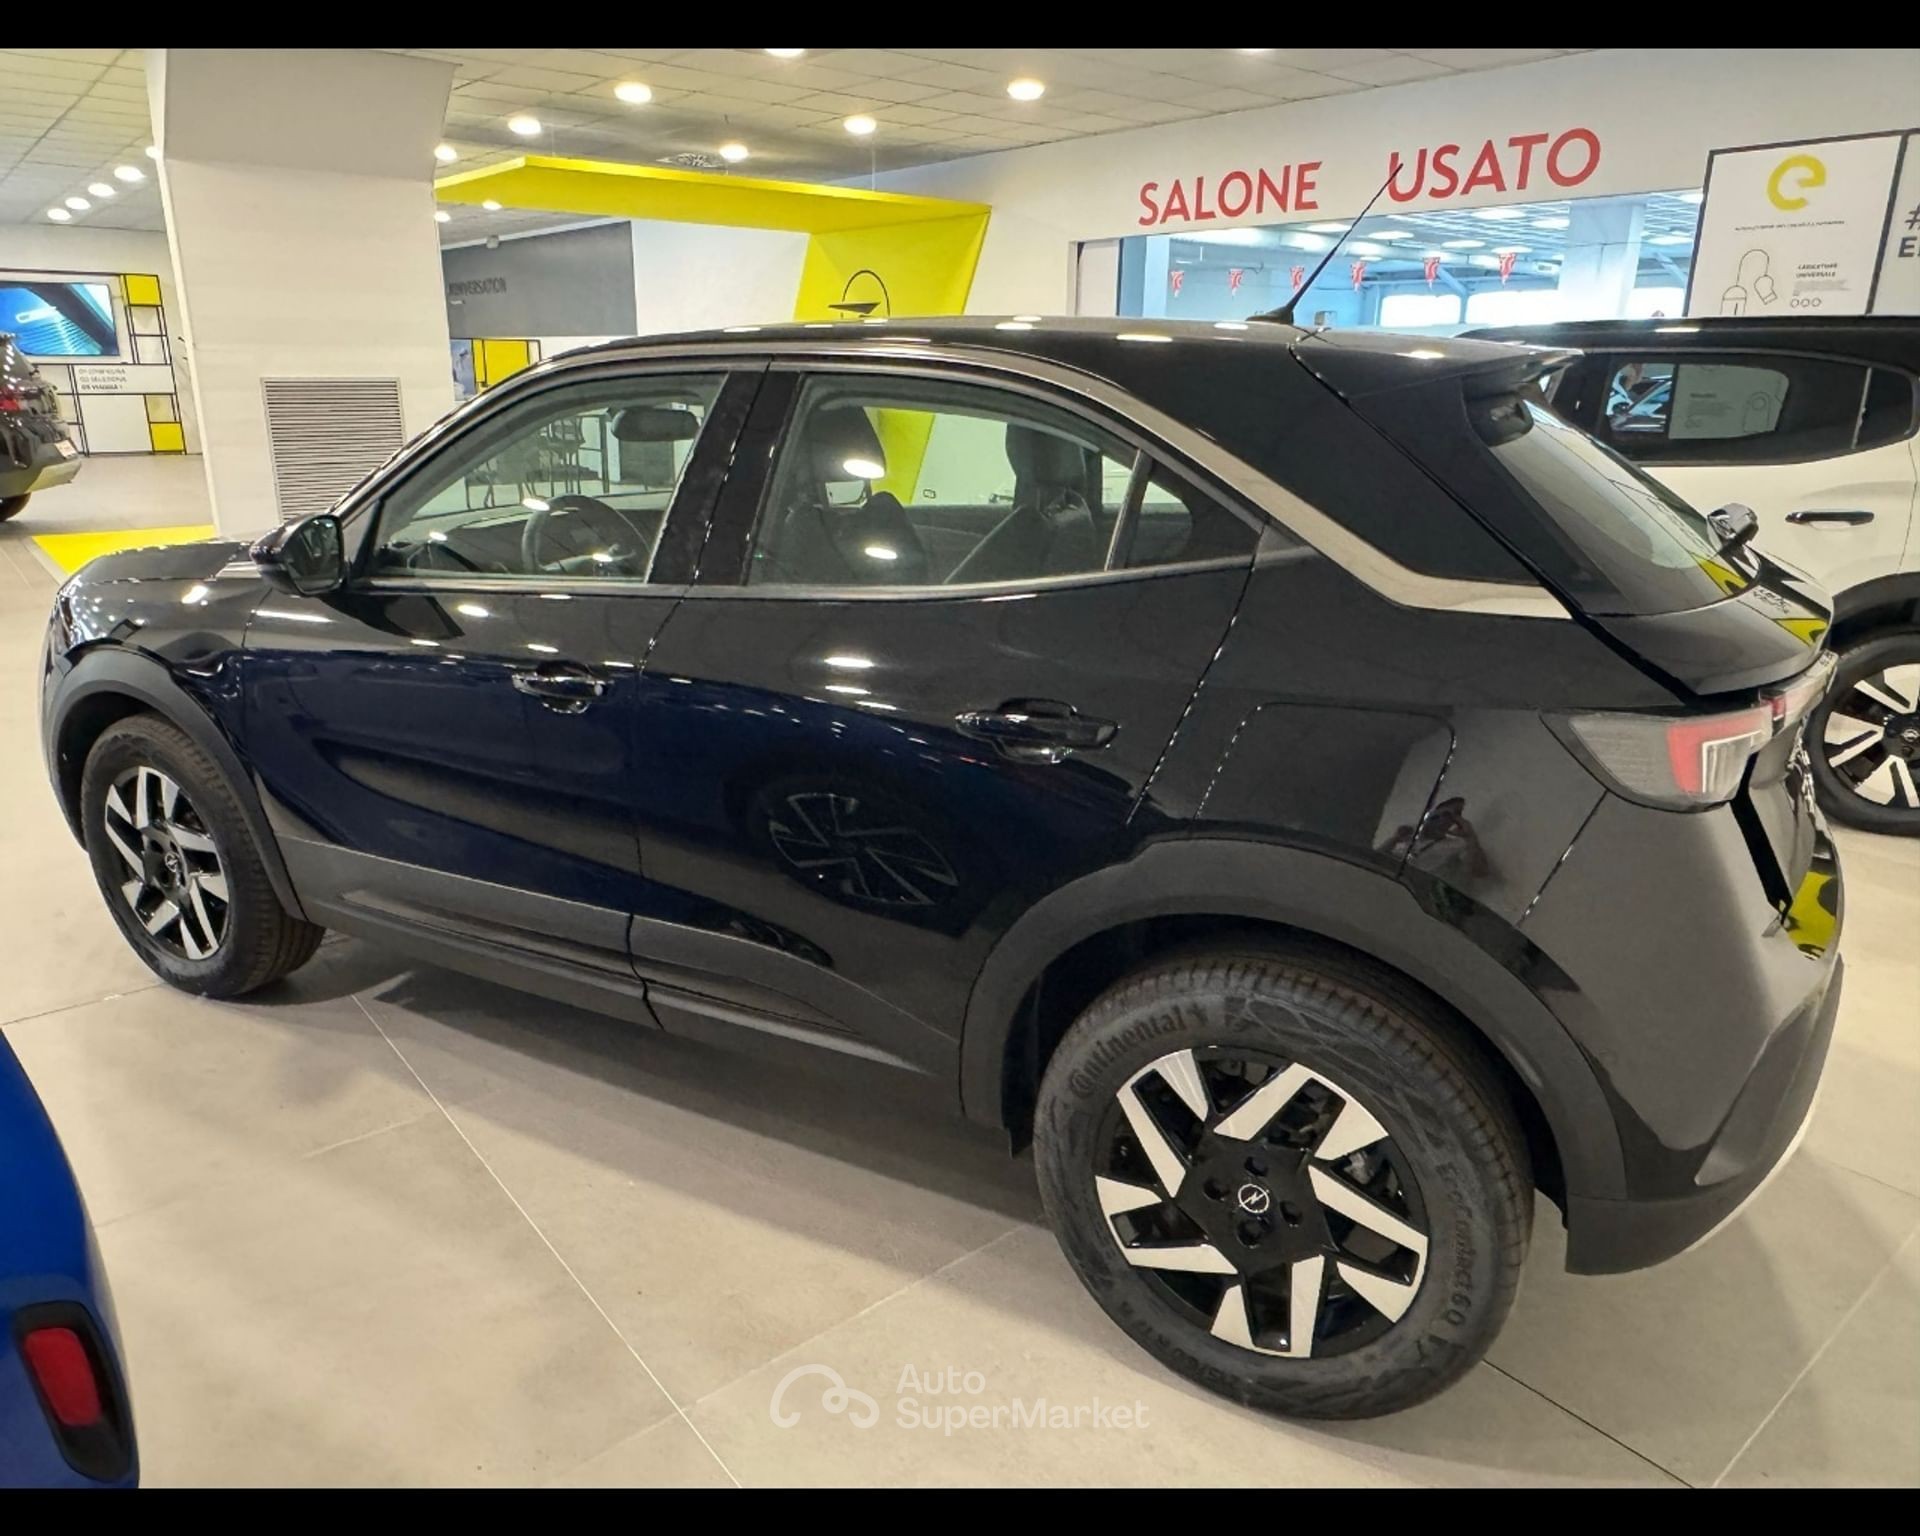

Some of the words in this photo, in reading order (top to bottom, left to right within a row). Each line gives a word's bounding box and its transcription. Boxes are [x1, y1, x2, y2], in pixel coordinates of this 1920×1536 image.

[1138, 160, 1322, 226] SALONE
[1388, 127, 1601, 202] USATO
[1898, 236, 1920, 258] E
[1069, 1004, 1188, 1099] Continental
